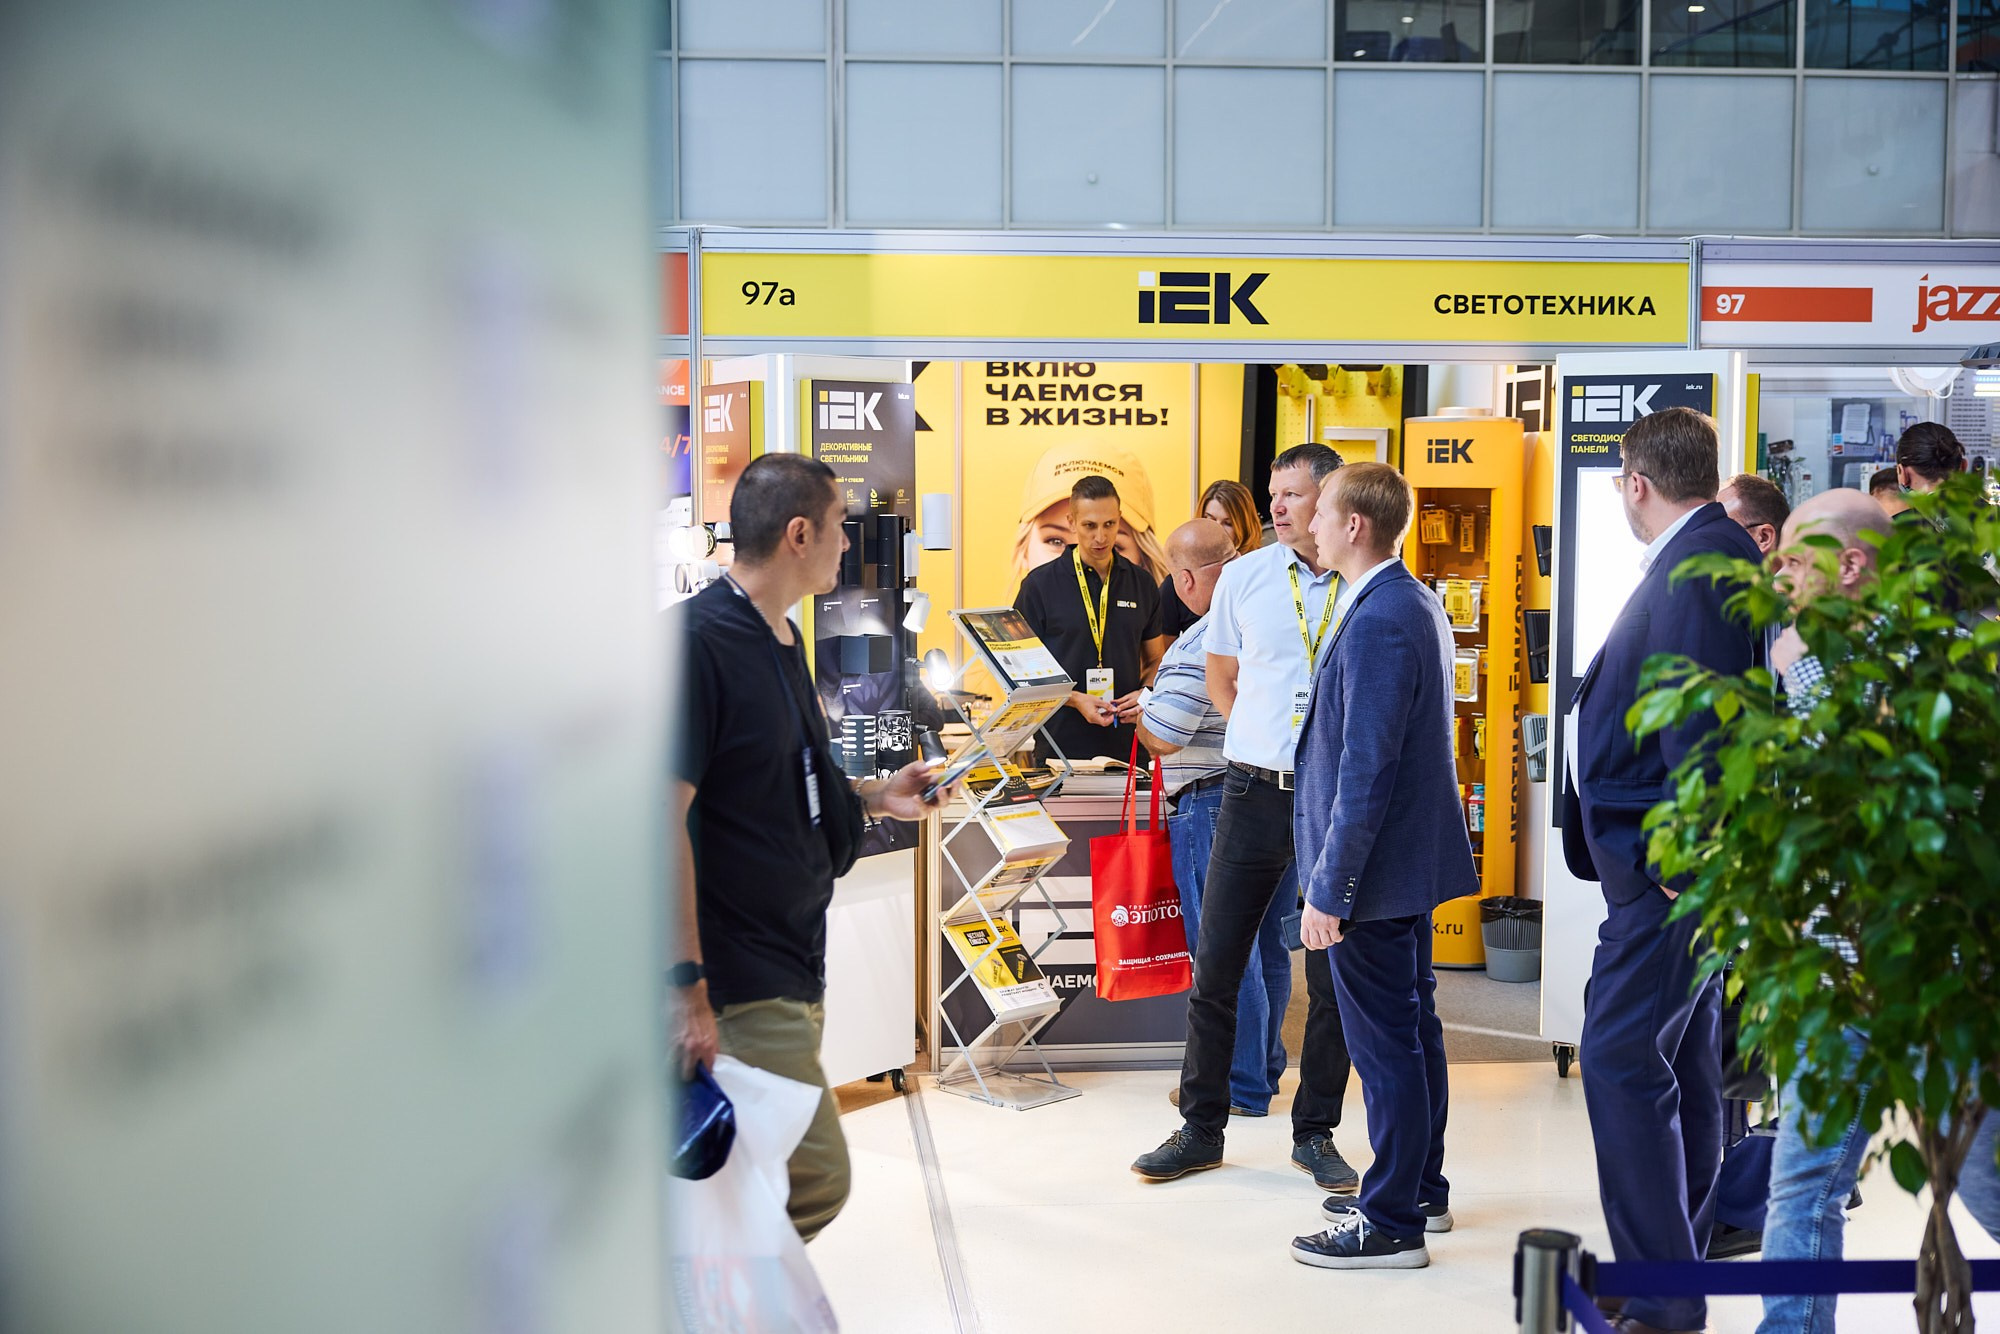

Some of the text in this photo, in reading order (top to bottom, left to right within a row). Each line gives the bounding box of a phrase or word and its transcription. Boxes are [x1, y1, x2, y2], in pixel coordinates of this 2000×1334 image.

[741, 281, 796, 306] 97a
[1434, 294, 1657, 316] СВЕТОТЕХНИКА
[1716, 293, 1746, 314] 97
[986, 362, 1097, 377] ВКЛЮ
[986, 384, 1143, 401] ЧАЕМСЯ
[986, 408, 1169, 426] В ЖИЗНЬ!
[820, 443, 873, 452] ДЕКОРАТИВНЫЕ
[1571, 445, 1609, 453] ПАНЕЛИ
[820, 455, 869, 463] СВЕТИЛЬНИКИ
[1055, 459, 1125, 477] ВКЛЮЧАЕМСЯ
[1063, 466, 1104, 475] ЖИЗНЬ!
[1118, 957, 1151, 965] ЗАЩИЩАЯ
[1046, 974, 1097, 989] АЕМ
